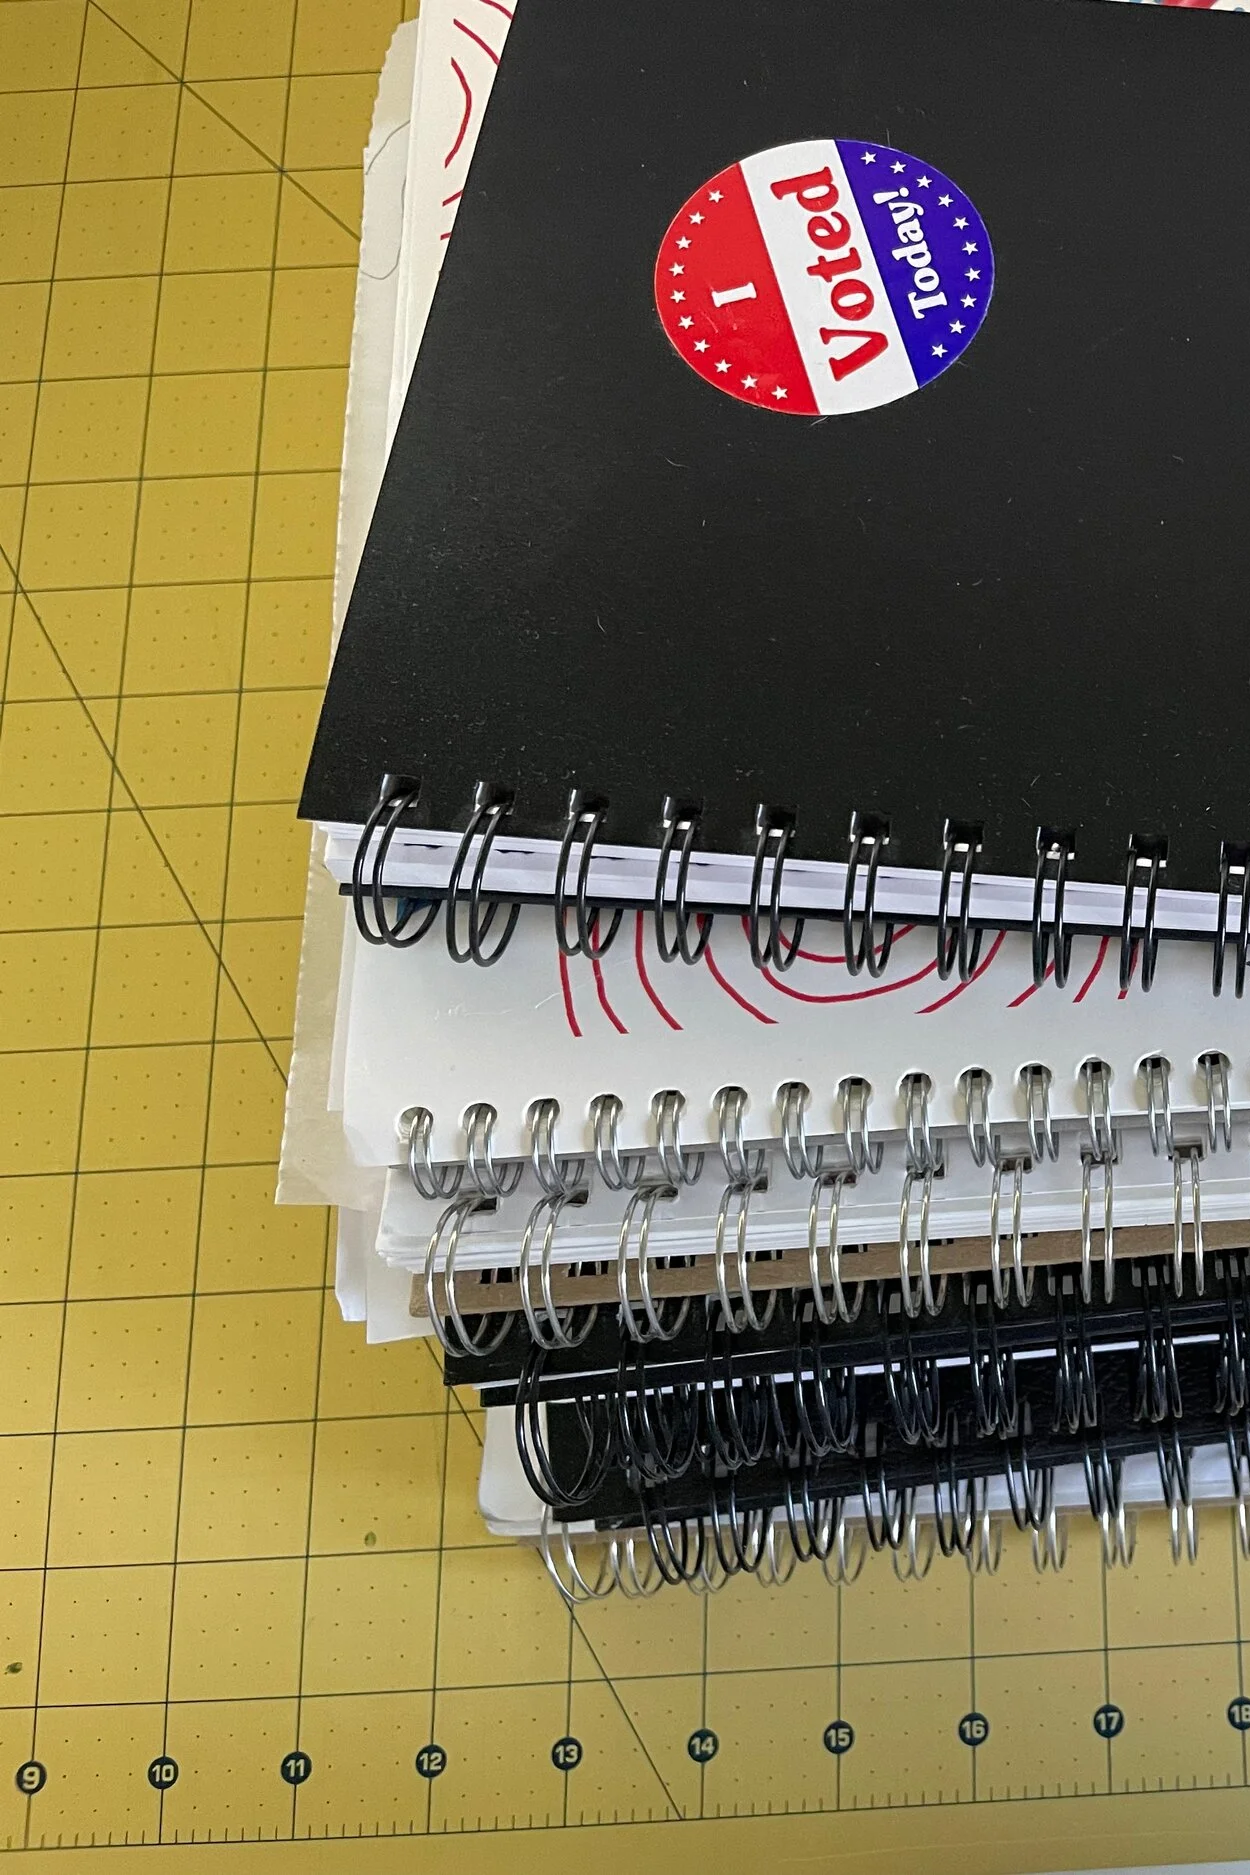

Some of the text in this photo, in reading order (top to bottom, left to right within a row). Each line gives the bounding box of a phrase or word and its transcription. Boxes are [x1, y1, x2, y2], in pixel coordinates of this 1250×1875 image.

[711, 281, 757, 307] I
[770, 166, 889, 382] Voted
[872, 186, 948, 320] Today!
[22, 1766, 40, 1790] 9
[151, 1764, 175, 1783] 10
[286, 1758, 305, 1777] 11
[419, 1752, 442, 1771] 12
[555, 1744, 578, 1764] 13
[691, 1736, 714, 1755] 14
[827, 1728, 850, 1747] 15
[962, 1720, 985, 1739] 16
[1097, 1712, 1120, 1731] 17
